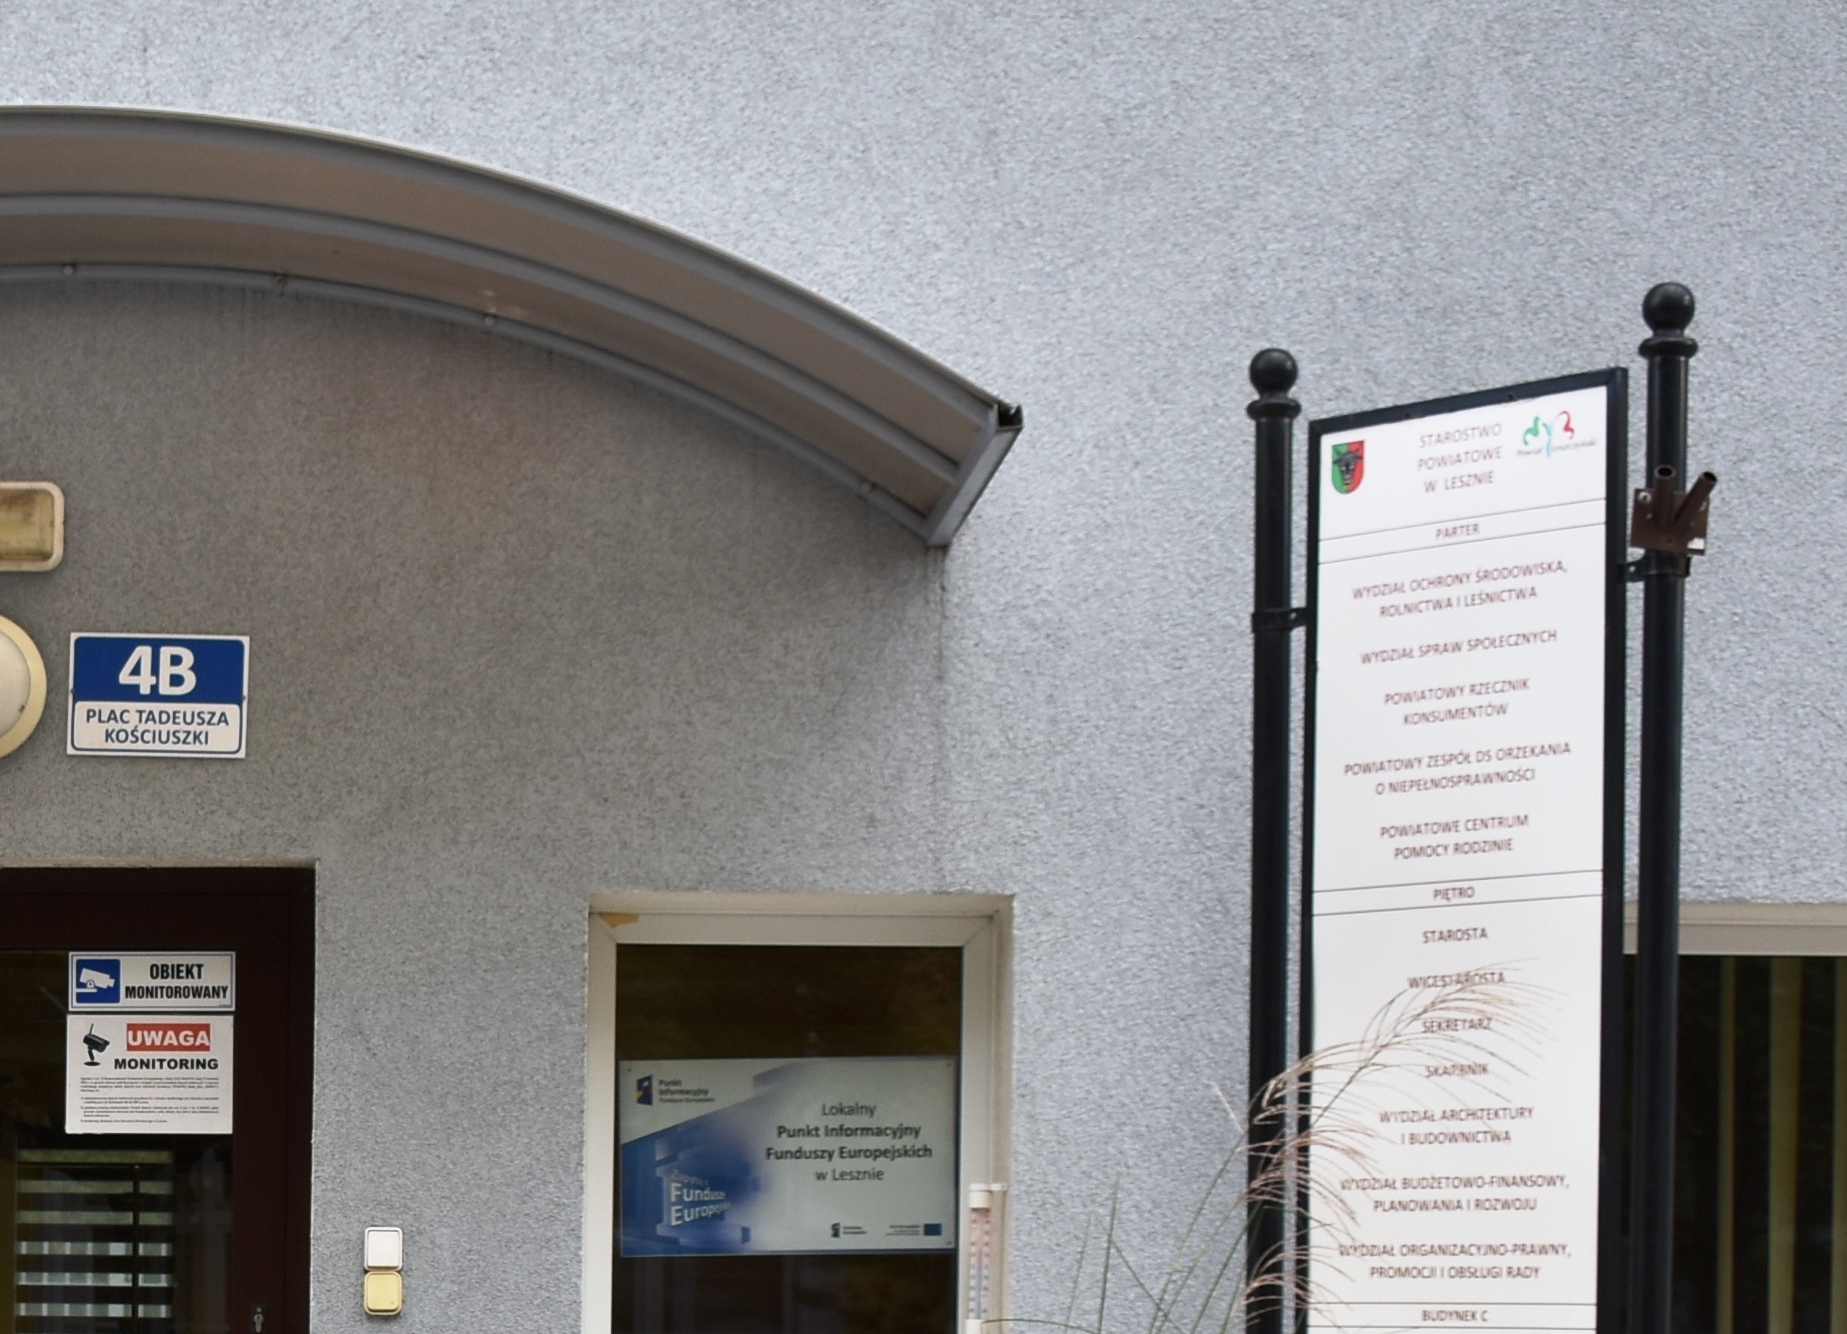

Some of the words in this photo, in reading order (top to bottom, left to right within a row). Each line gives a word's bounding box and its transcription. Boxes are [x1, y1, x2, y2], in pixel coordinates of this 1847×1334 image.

[1419, 424, 1502, 448] STAROSTWO
[1417, 446, 1503, 471] POWIATOWE
[1424, 480, 1436, 493] W
[1445, 471, 1494, 491] LESZNIE
[1435, 524, 1479, 540] PARTER
[1353, 580, 1406, 600] WYDZIAŁ
[1411, 572, 1471, 593] OCHRONY
[1475, 560, 1567, 585] ŚRODOWISKA,
[1379, 597, 1454, 618] ROLNICTWA
[1465, 587, 1537, 608] LEŚNICTWA
[1361, 645, 1415, 665] WYDZIAŁ
[1419, 639, 1463, 658] SPRAW
[1467, 630, 1557, 653] SPOŁECZNYCH
[118, 645, 197, 696] 4B
[1385, 685, 1465, 705] POWIATOWY
[1469, 678, 1530, 697] RZECZNIK
[86, 708, 129, 726] PLAC
[136, 708, 230, 727] TADEUSZA
[1403, 703, 1508, 726] KONSUMENTÓW
[104, 725, 209, 745] KOŚCIUSZKI
[1344, 756, 1422, 776] POWIATOWY
[1427, 748, 1471, 767] ZESPÓŁ
[1476, 749, 1491, 763] DS
[1496, 742, 1571, 762] ORZEKANIA
[1376, 782, 1385, 795] O
[1389, 769, 1535, 794] NIEPEŁNOSPRAWNOŚCI
[1380, 820, 1460, 839] POWIATOWE
[1465, 814, 1528, 831] CENTRUM
[1394, 842, 1449, 859] POMOCY
[1454, 838, 1513, 855] RODZINIE
[1433, 886, 1475, 903] PIĘTRO
[1422, 927, 1488, 944] STAROSTA
[149, 963, 204, 980] OBIEKT
[1407, 972, 1506, 989] WICESTAROSTA
[125, 983, 229, 1000] MONITOROWANY
[1422, 1018, 1491, 1034] SEKRETARZ
[128, 1030, 210, 1046] UWAGA
[114, 1058, 218, 1069] MONITORING
[659, 1079, 682, 1087] Punkt
[822, 1102, 876, 1118] Lokalny
[1379, 1109, 1436, 1123] WYDZIAŁ
[1440, 1107, 1533, 1123] ARCHITEKTURY
[776, 1124, 820, 1138] Punkt
[824, 1124, 921, 1140] Informacyjny
[1409, 1130, 1511, 1145] BUDOWNICTWA
[766, 1147, 835, 1161] Funduszy
[839, 1145, 932, 1161] Europejskich
[815, 1170, 827, 1181] w
[832, 1167, 884, 1182] Lesznie
[1341, 1177, 1398, 1191] WYDZIAŁ
[1402, 1173, 1569, 1190] BUDŻETOWO-FINANSOWY,
[1374, 1198, 1463, 1212] PLANOWANIA
[1474, 1198, 1537, 1211] ROZWOJU
[1338, 1244, 1395, 1257] WYDZIAŁ
[1400, 1243, 1571, 1258] ORGANIZACYJNO-PRAWNY,
[1370, 1266, 1436, 1279] PROMOCJI
[1448, 1266, 1502, 1280] OBSŁUGI
[1506, 1266, 1540, 1280] RADY
[1422, 1310, 1478, 1322] BUDYNEK
[1481, 1310, 1488, 1322] C
